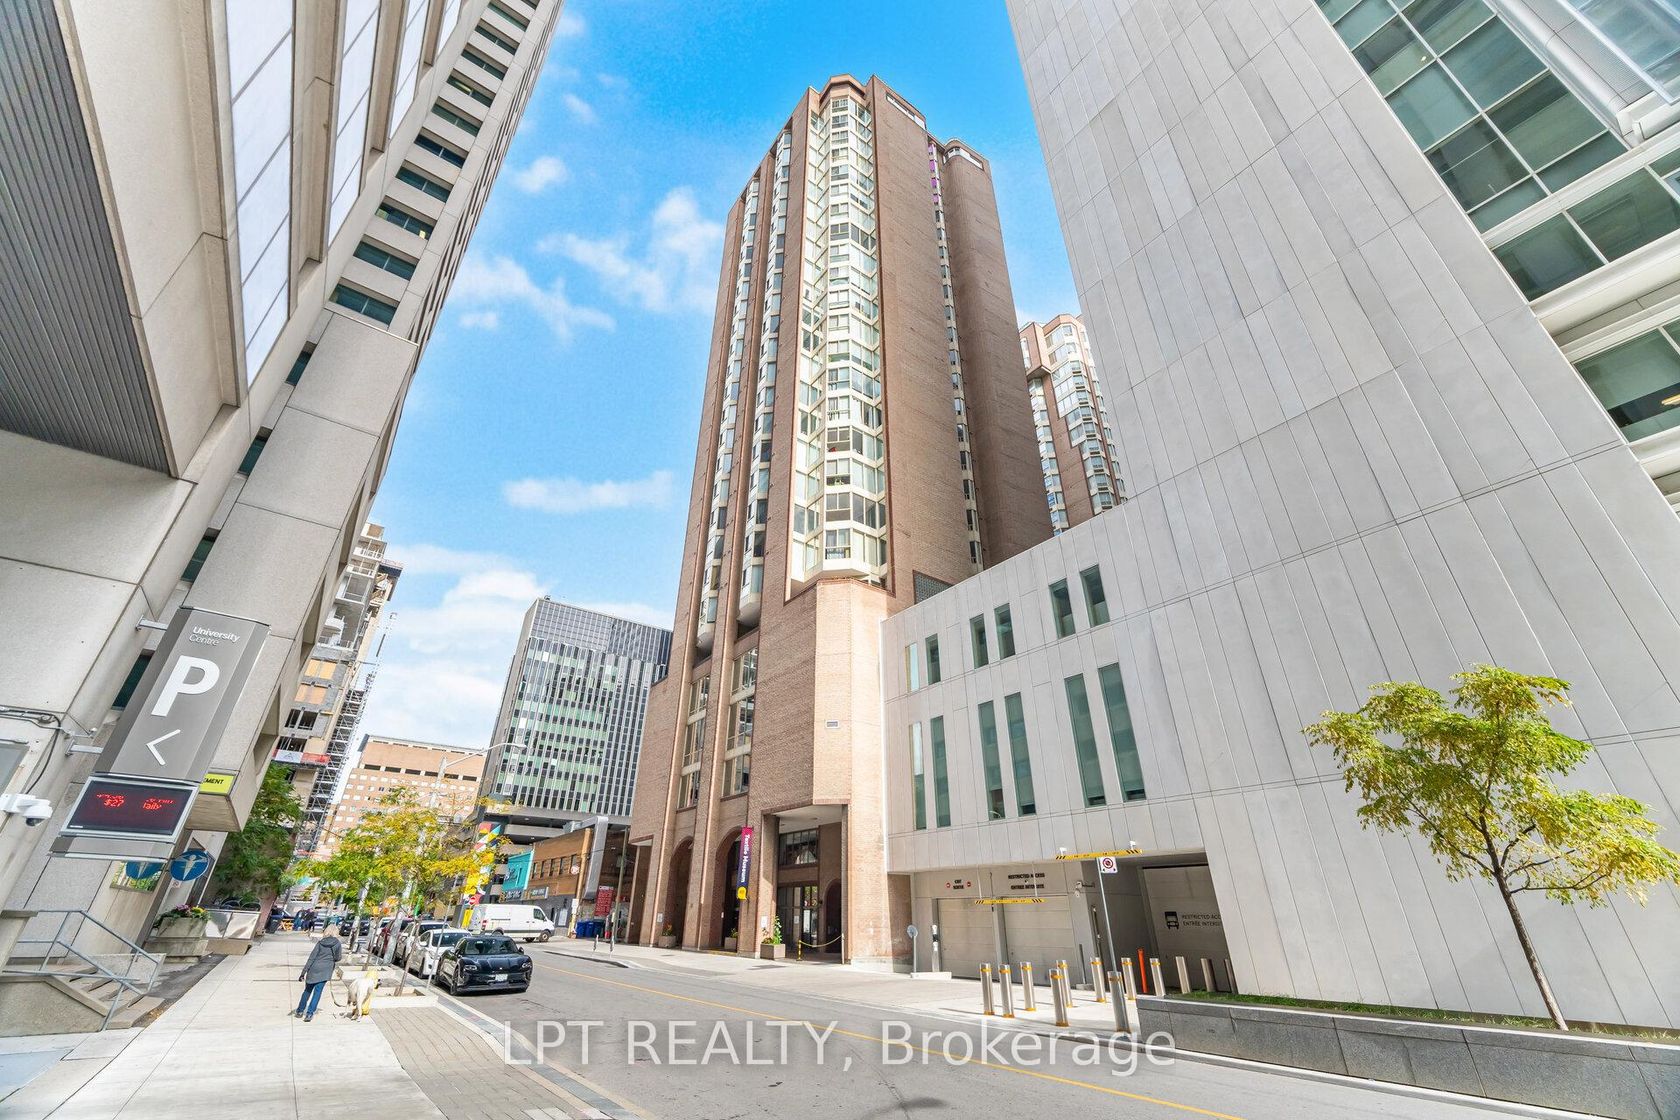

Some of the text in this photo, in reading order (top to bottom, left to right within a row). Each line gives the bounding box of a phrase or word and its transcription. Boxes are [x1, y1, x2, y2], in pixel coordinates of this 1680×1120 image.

[189, 633, 219, 646] Centre
[192, 626, 240, 643] University
[151, 654, 220, 717] P
[740, 834, 751, 883] Textile Museum
